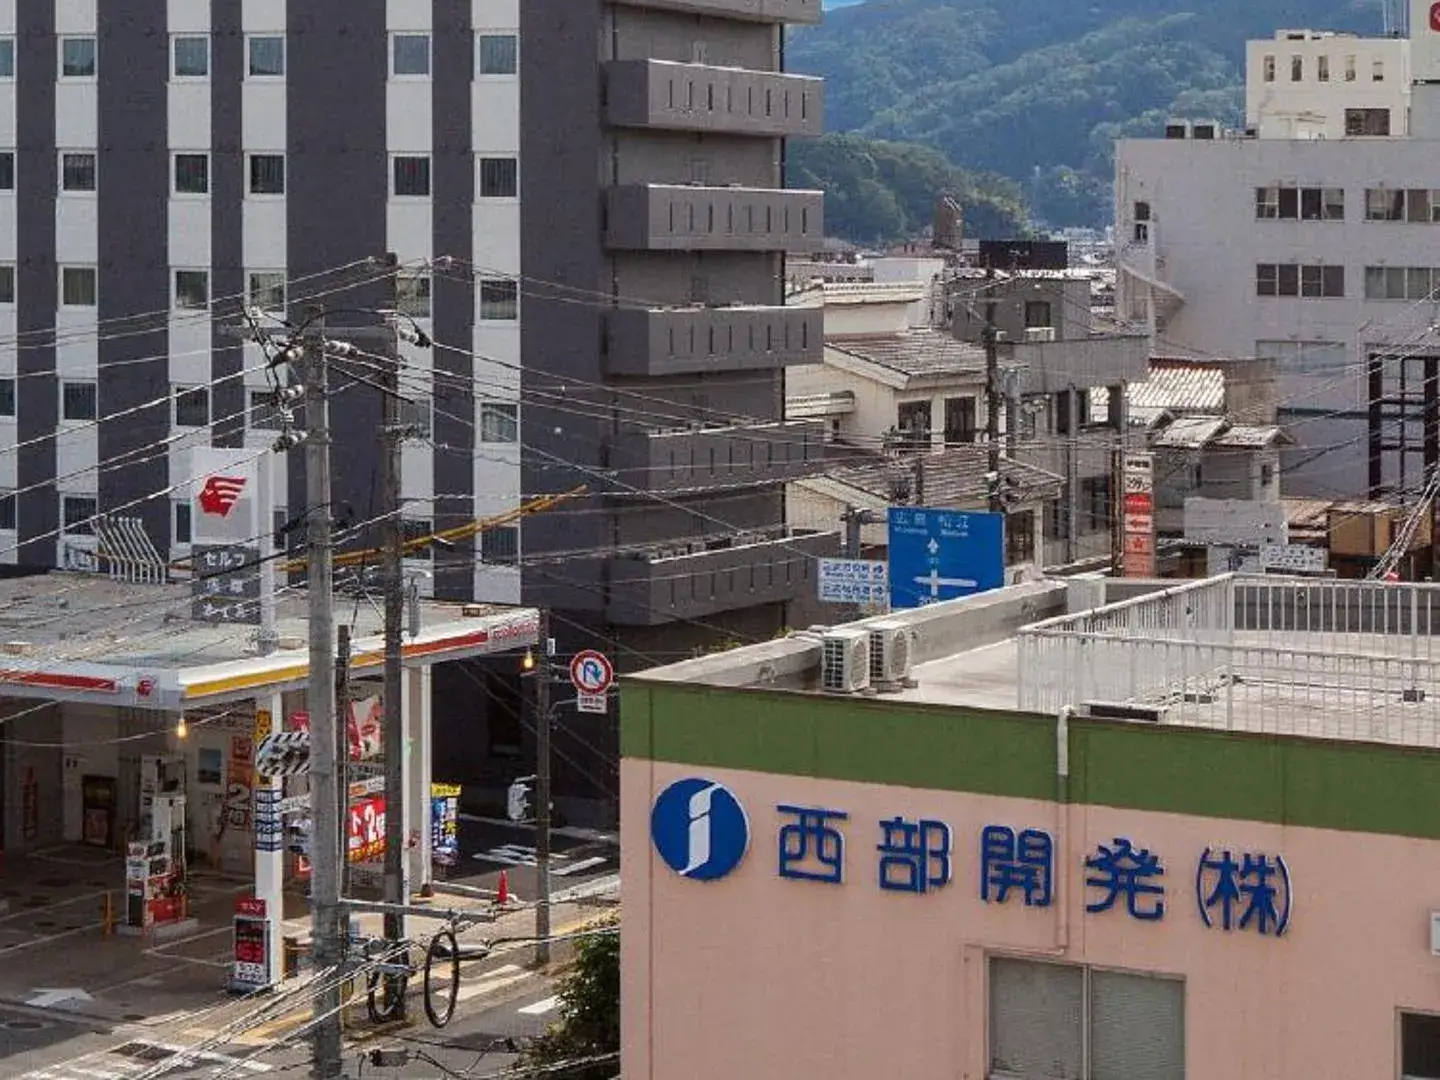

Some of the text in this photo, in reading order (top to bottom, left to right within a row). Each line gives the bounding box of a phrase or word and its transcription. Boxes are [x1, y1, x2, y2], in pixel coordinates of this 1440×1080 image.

[775, 804, 1294, 937] 西部開発(株)
